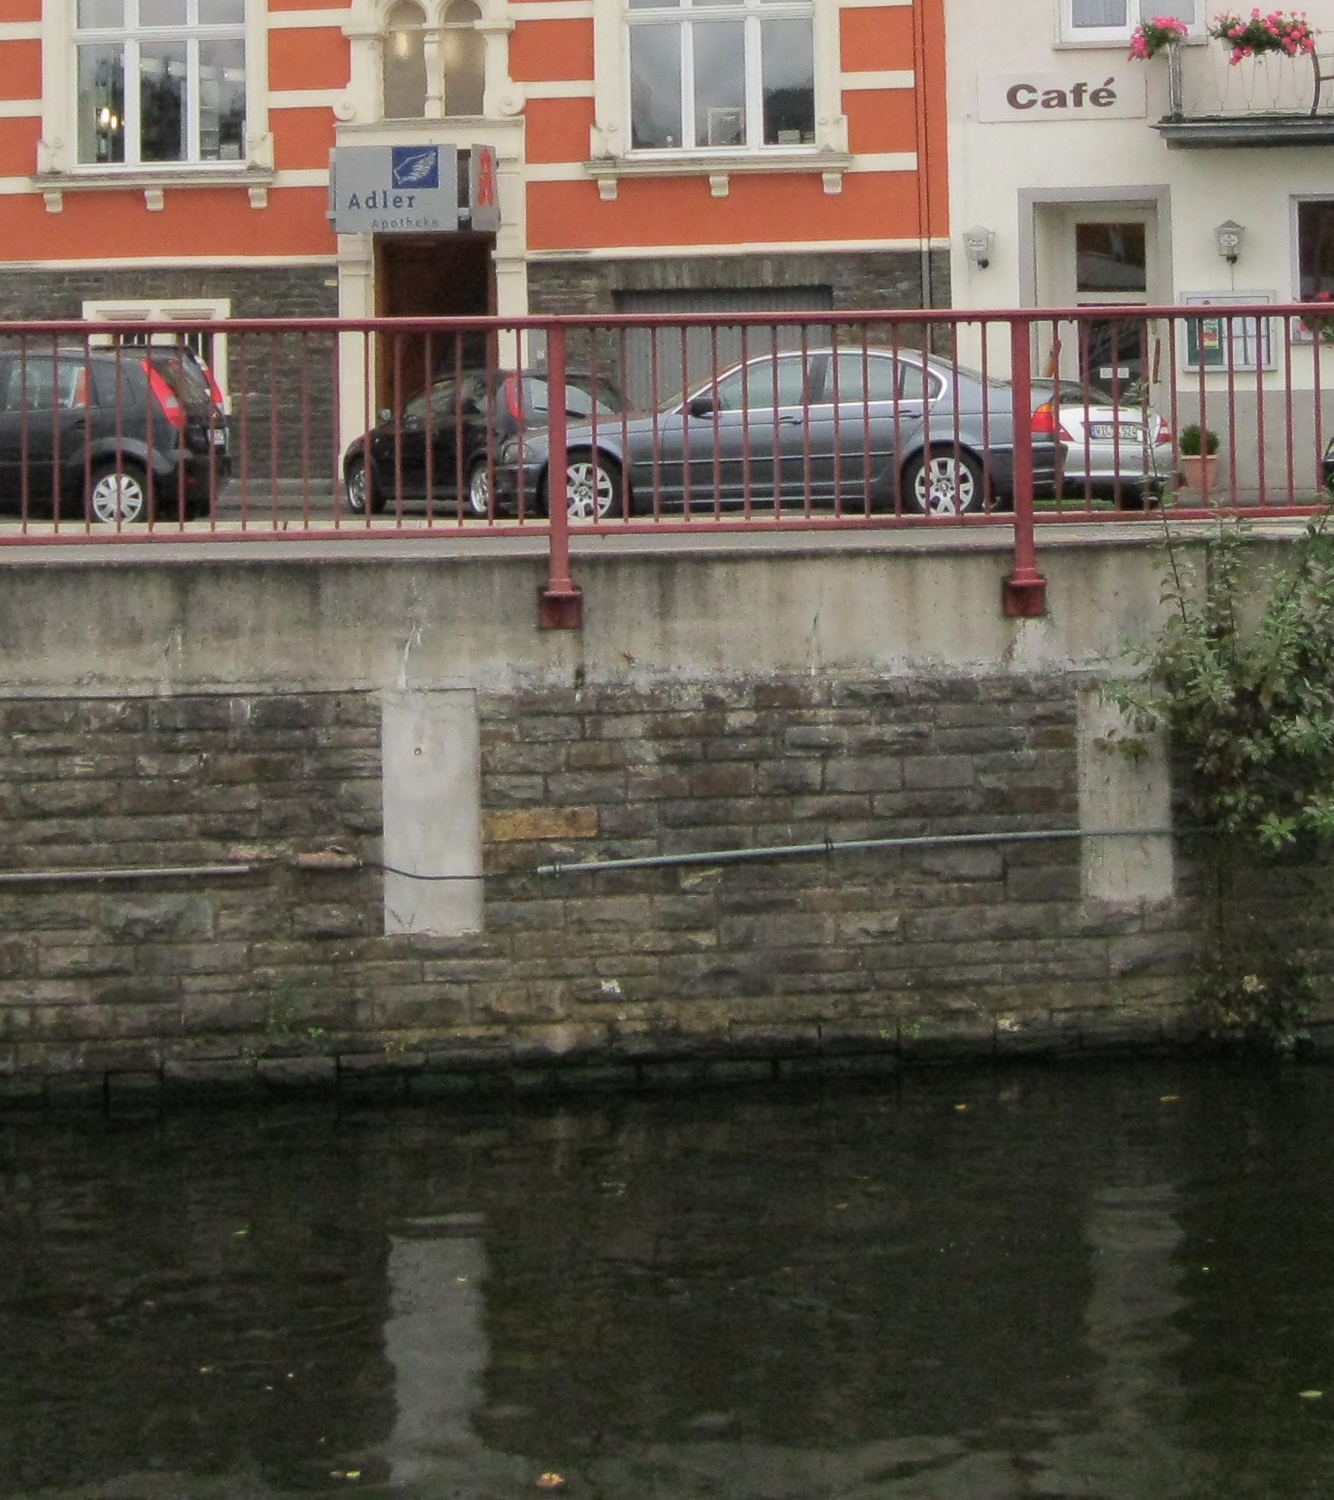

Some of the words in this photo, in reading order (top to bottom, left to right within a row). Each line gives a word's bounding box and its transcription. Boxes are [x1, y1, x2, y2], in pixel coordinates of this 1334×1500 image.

[1006, 76, 1117, 110] Café
[347, 190, 416, 210] Adler
[370, 216, 440, 231] Apotheke
